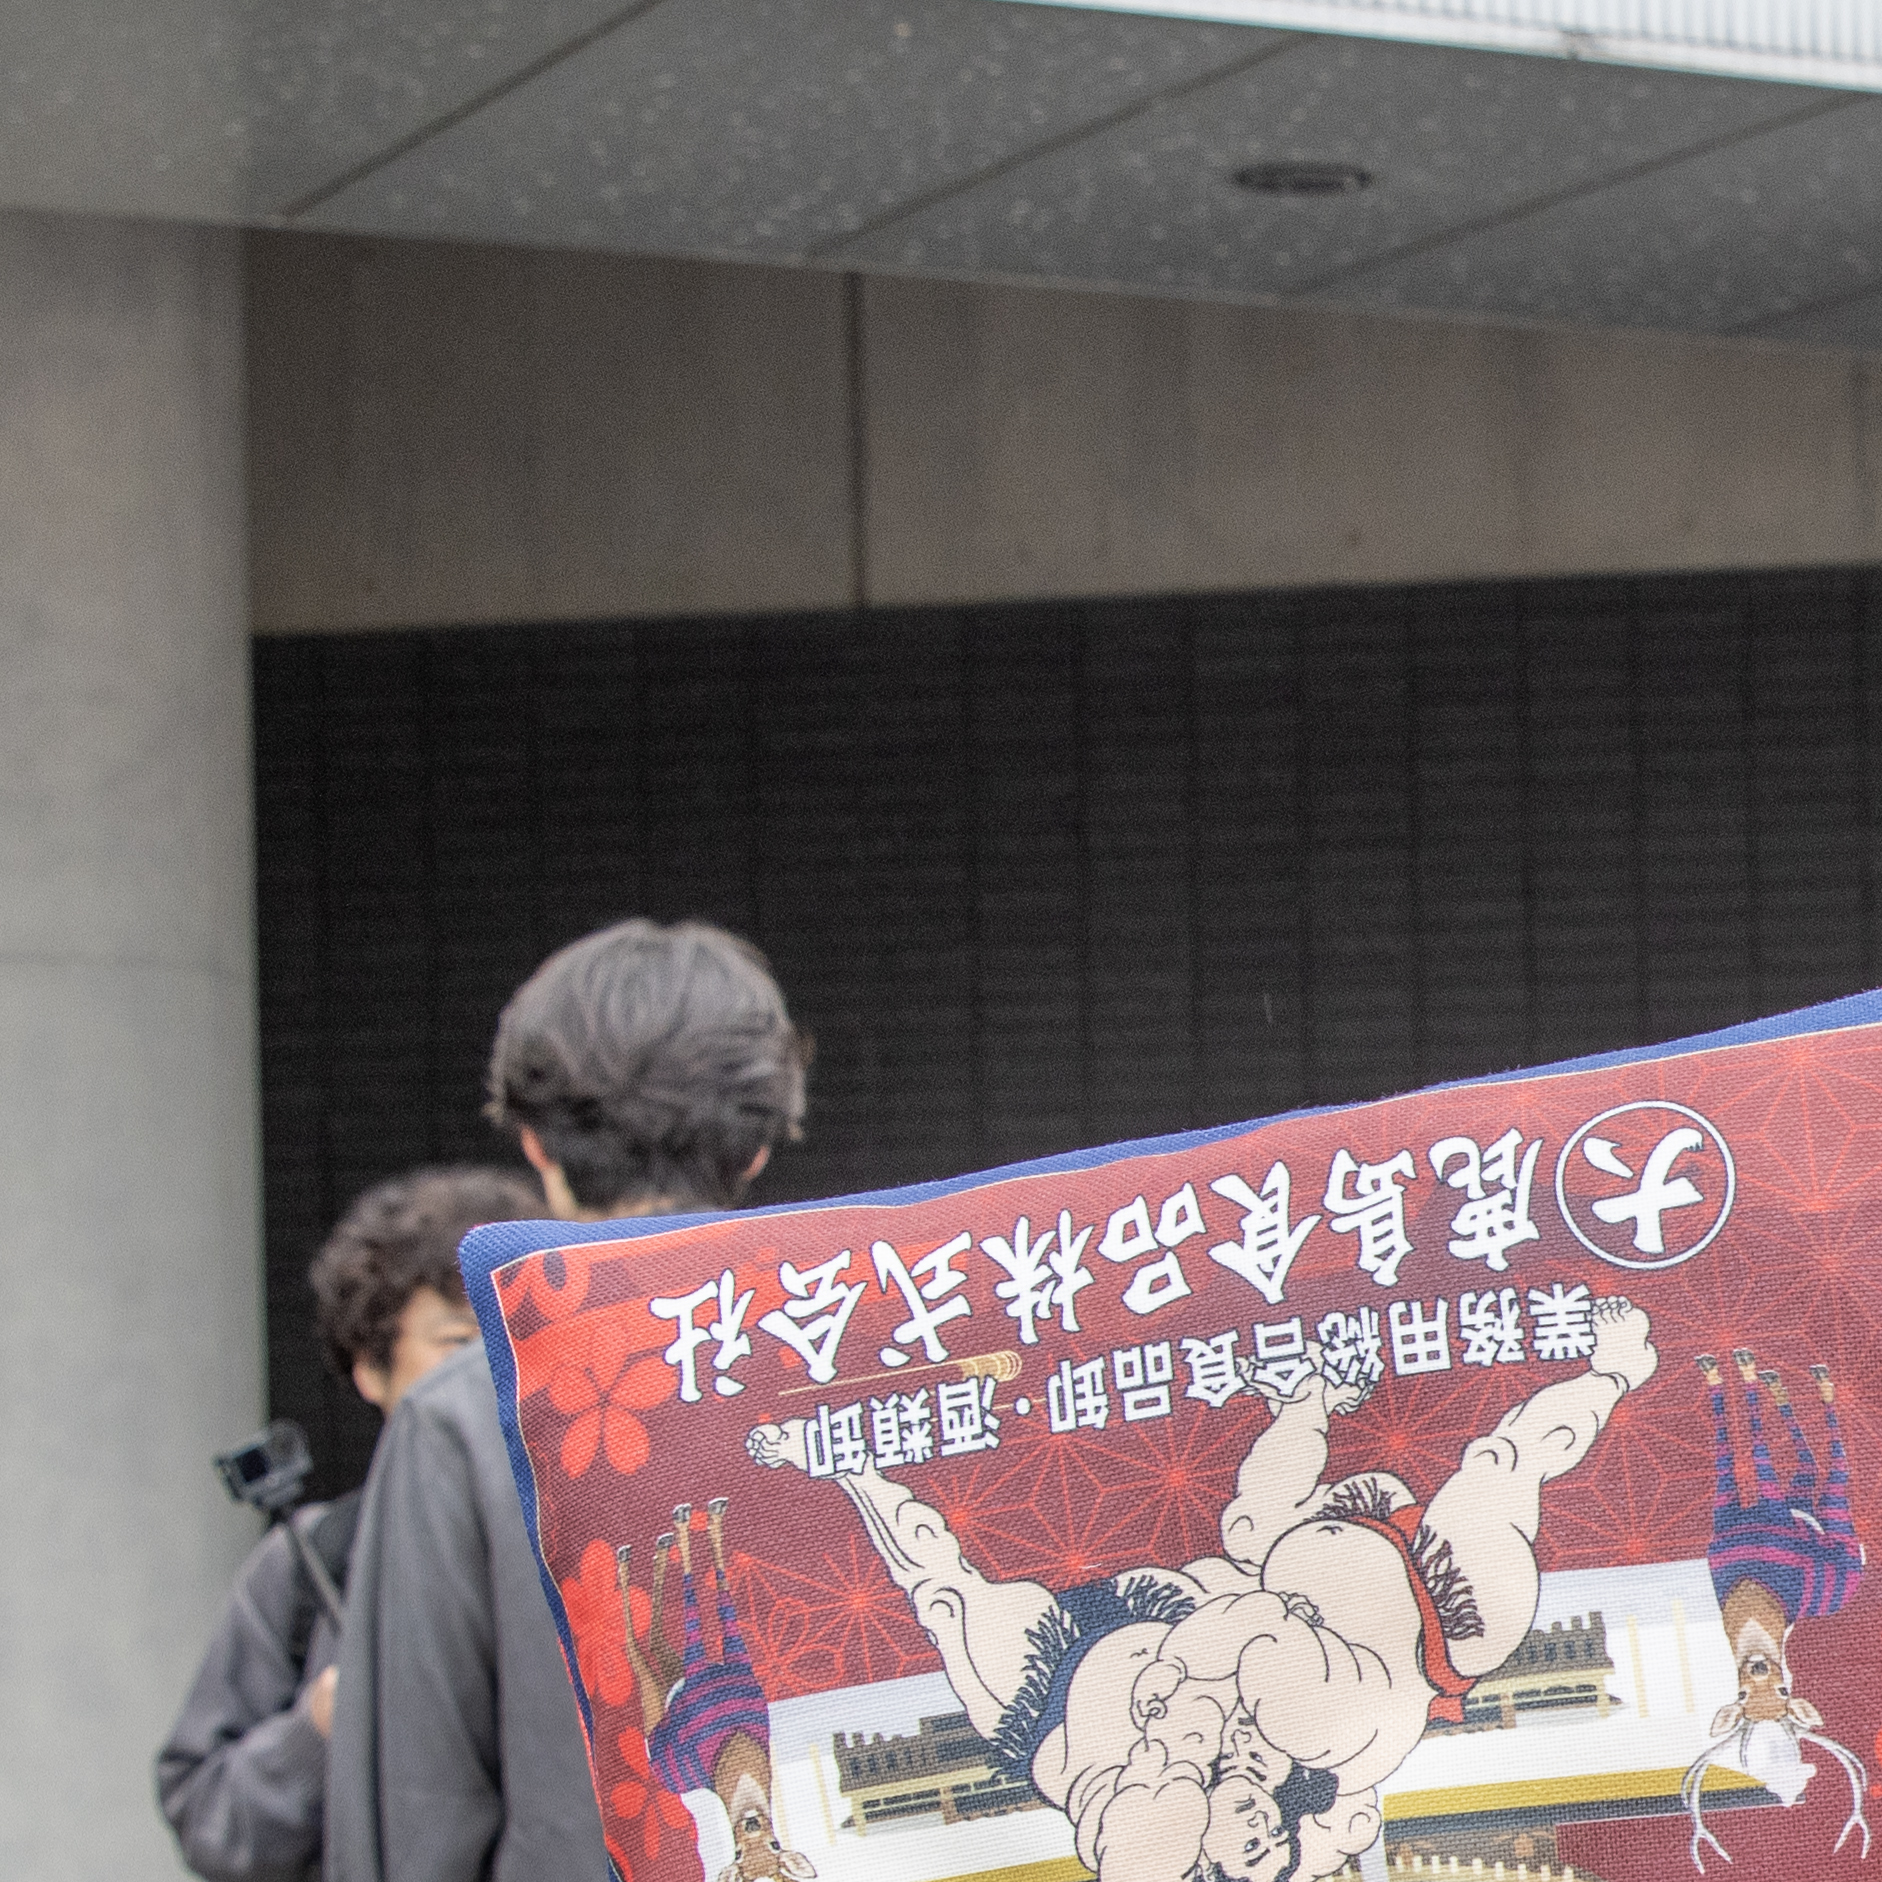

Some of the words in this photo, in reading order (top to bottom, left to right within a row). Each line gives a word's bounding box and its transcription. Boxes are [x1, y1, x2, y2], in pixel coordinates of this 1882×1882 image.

[649, 1128, 1543, 1402] 鹿島食品株式会社
